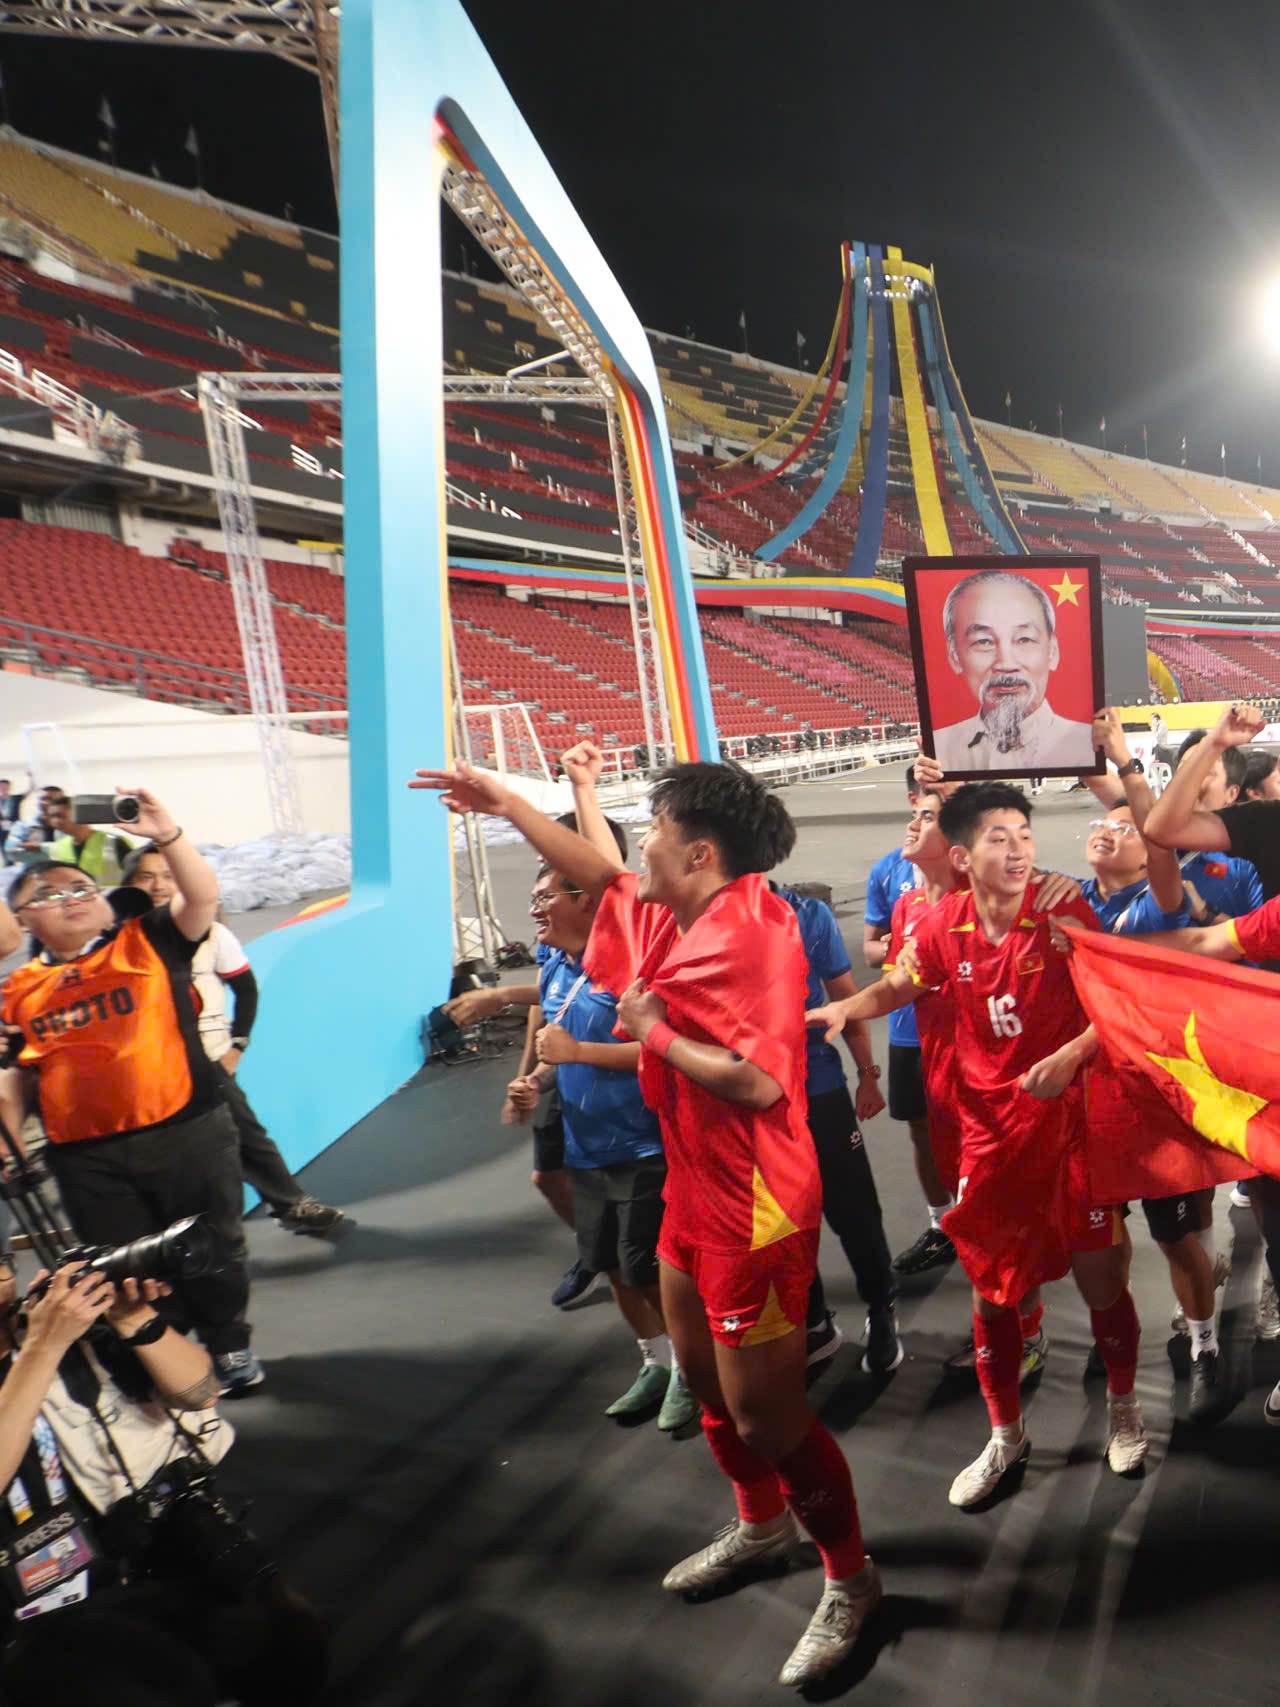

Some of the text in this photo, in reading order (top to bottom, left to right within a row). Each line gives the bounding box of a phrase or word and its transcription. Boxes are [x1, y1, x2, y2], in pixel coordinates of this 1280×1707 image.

[30, 986, 134, 1042] PHOTO
[986, 993, 1023, 1038] 16
[14, 1511, 76, 1555] PRESS
